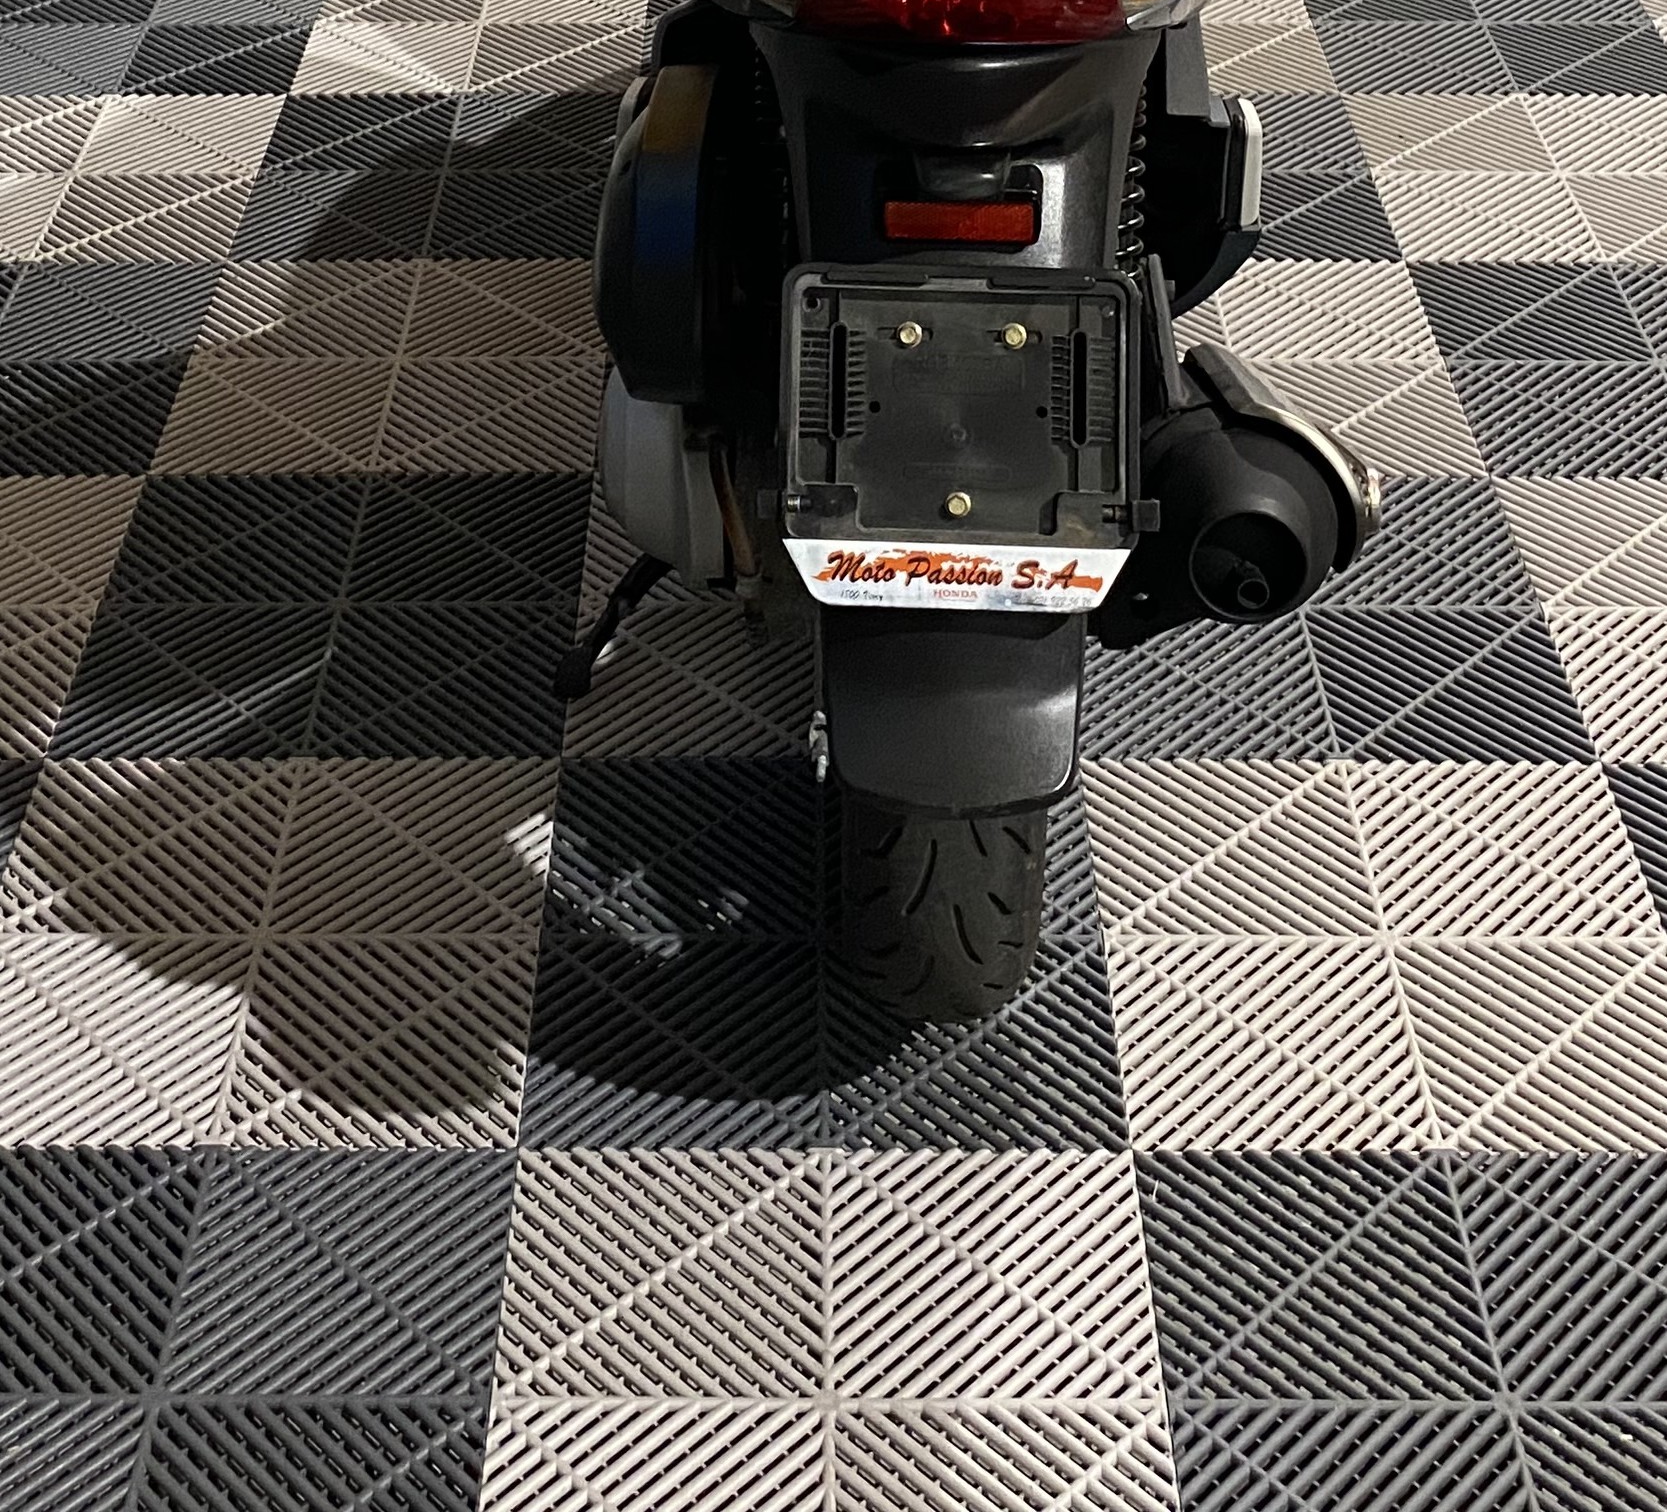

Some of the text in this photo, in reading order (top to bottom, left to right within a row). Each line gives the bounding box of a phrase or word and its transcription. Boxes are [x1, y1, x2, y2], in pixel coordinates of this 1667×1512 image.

[827, 550, 896, 584] Moto
[905, 551, 1003, 587] Passion
[933, 588, 978, 600] HONDA
